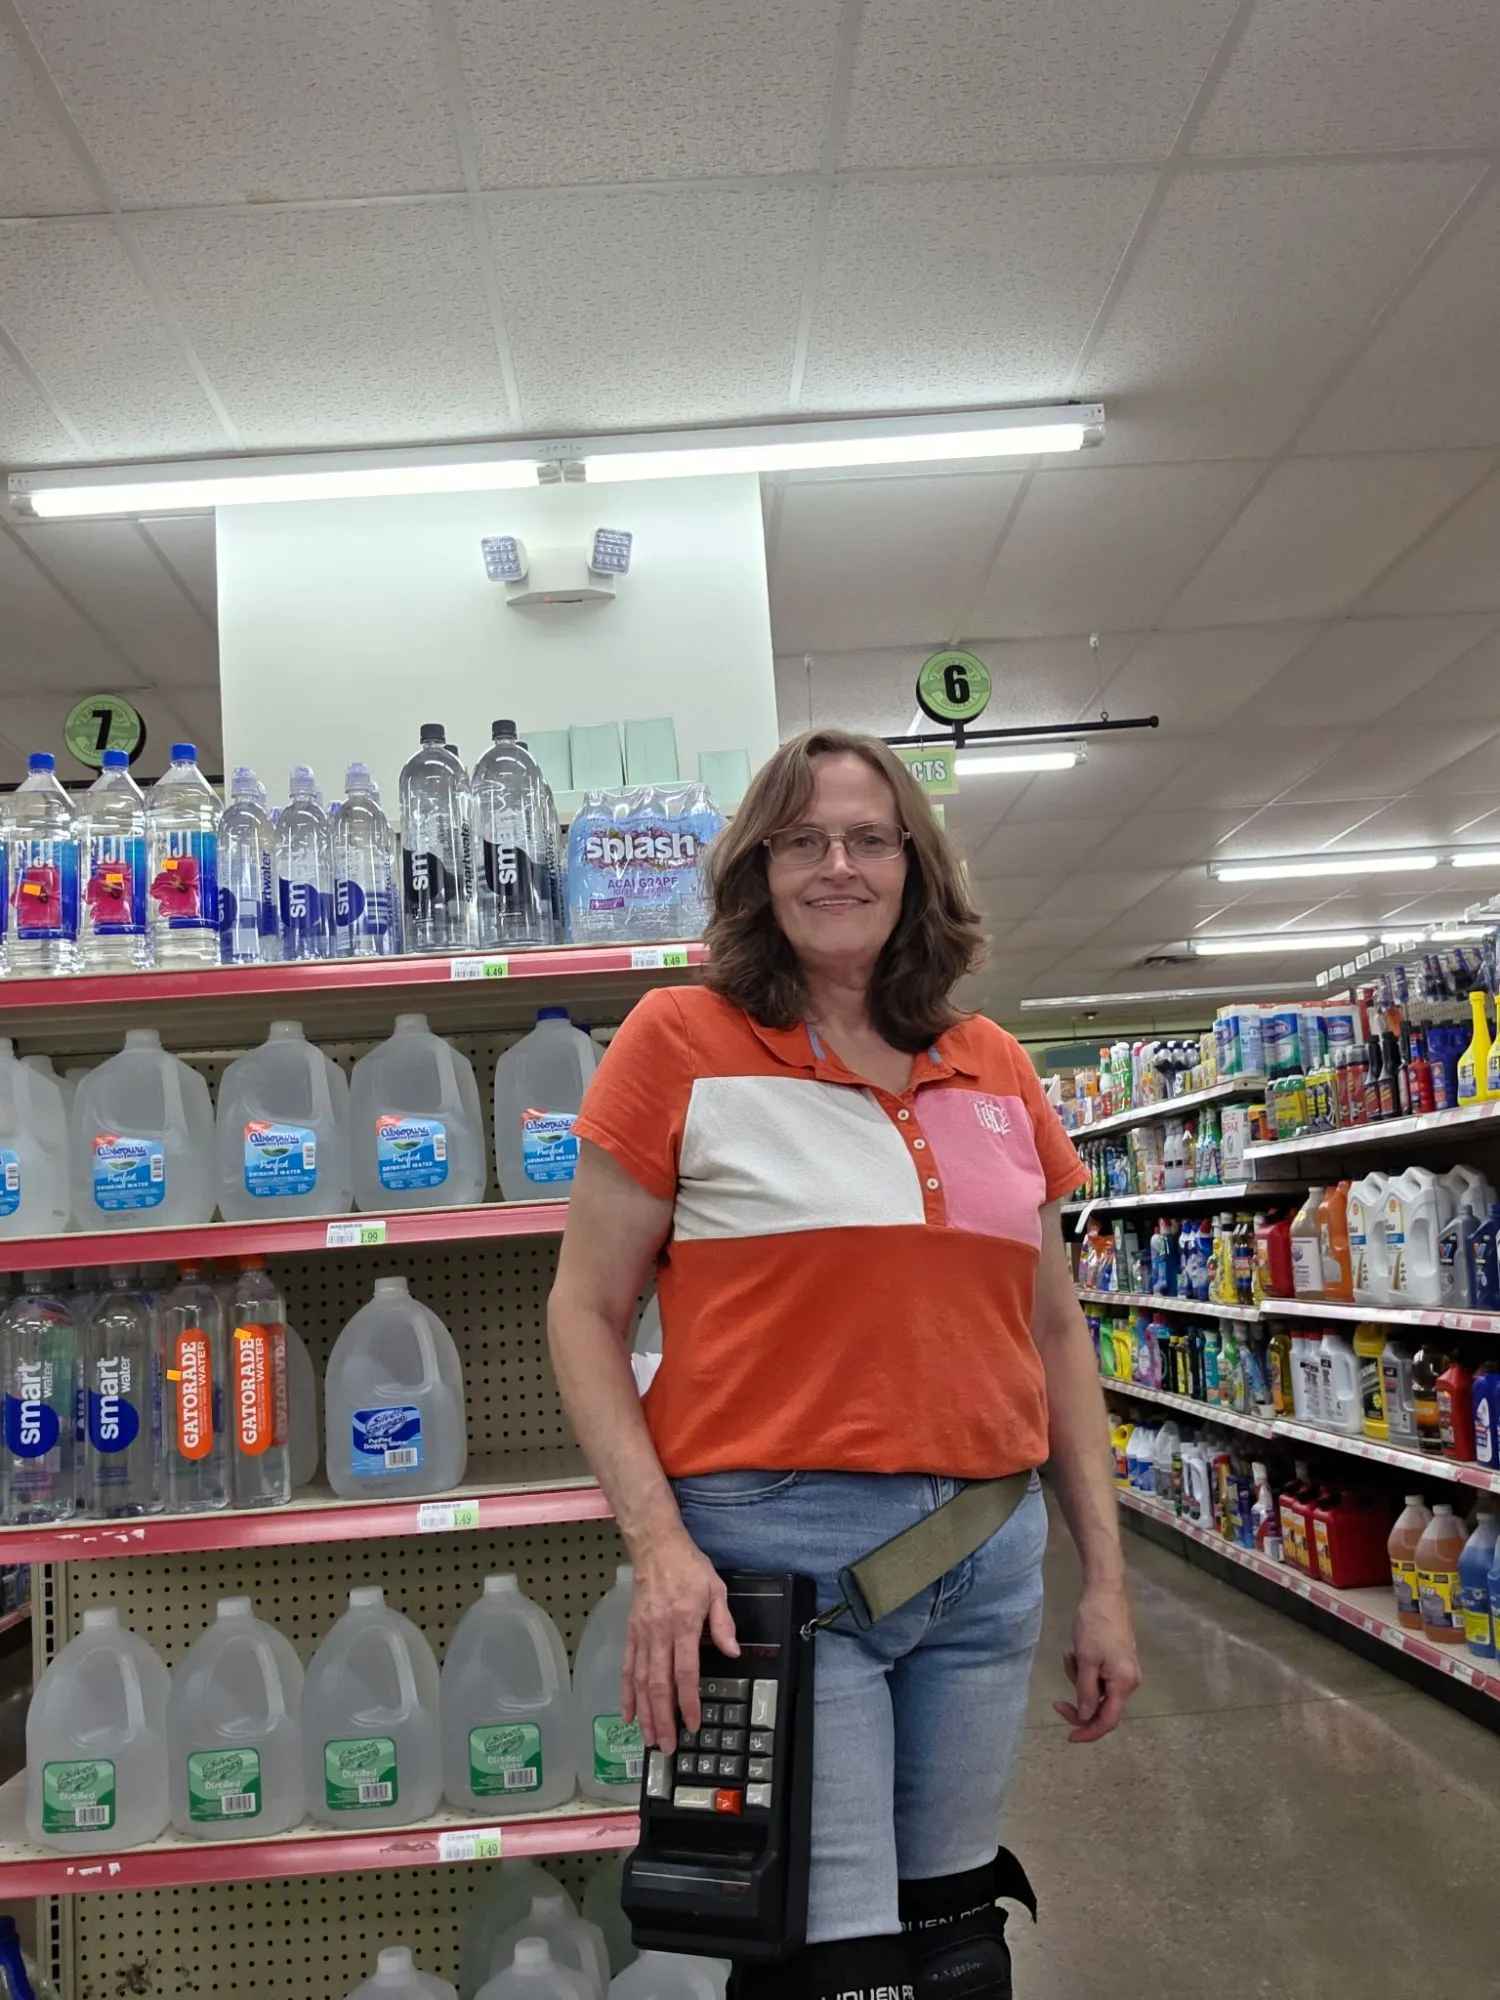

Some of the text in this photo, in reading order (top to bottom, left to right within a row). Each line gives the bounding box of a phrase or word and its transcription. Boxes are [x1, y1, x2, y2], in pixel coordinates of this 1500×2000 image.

[944, 664, 971, 704] 6
[92, 709, 112, 750] 7
[586, 832, 695, 864] splash
[485, 966, 503, 977] 4.49
[663, 956, 681, 967] 4.49
[556, 1153, 576, 1161] WATER
[360, 1231, 378, 1243] 1.99
[119, 1355, 131, 1394] water
[197, 1341, 206, 1386] WATER
[255, 1337, 264, 1382] WATER
[42, 1360, 53, 1398] water
[96, 1356, 119, 1440] smart
[181, 1341, 199, 1449] GATORADE
[239, 1337, 258, 1445] GATORADE
[18, 1360, 42, 1445] smart
[454, 1512, 472, 1525] 1.49
[59, 1791, 95, 1801] Distilled
[205, 1780, 241, 1790] Distilled
[480, 1843, 498, 1857] 1.49
